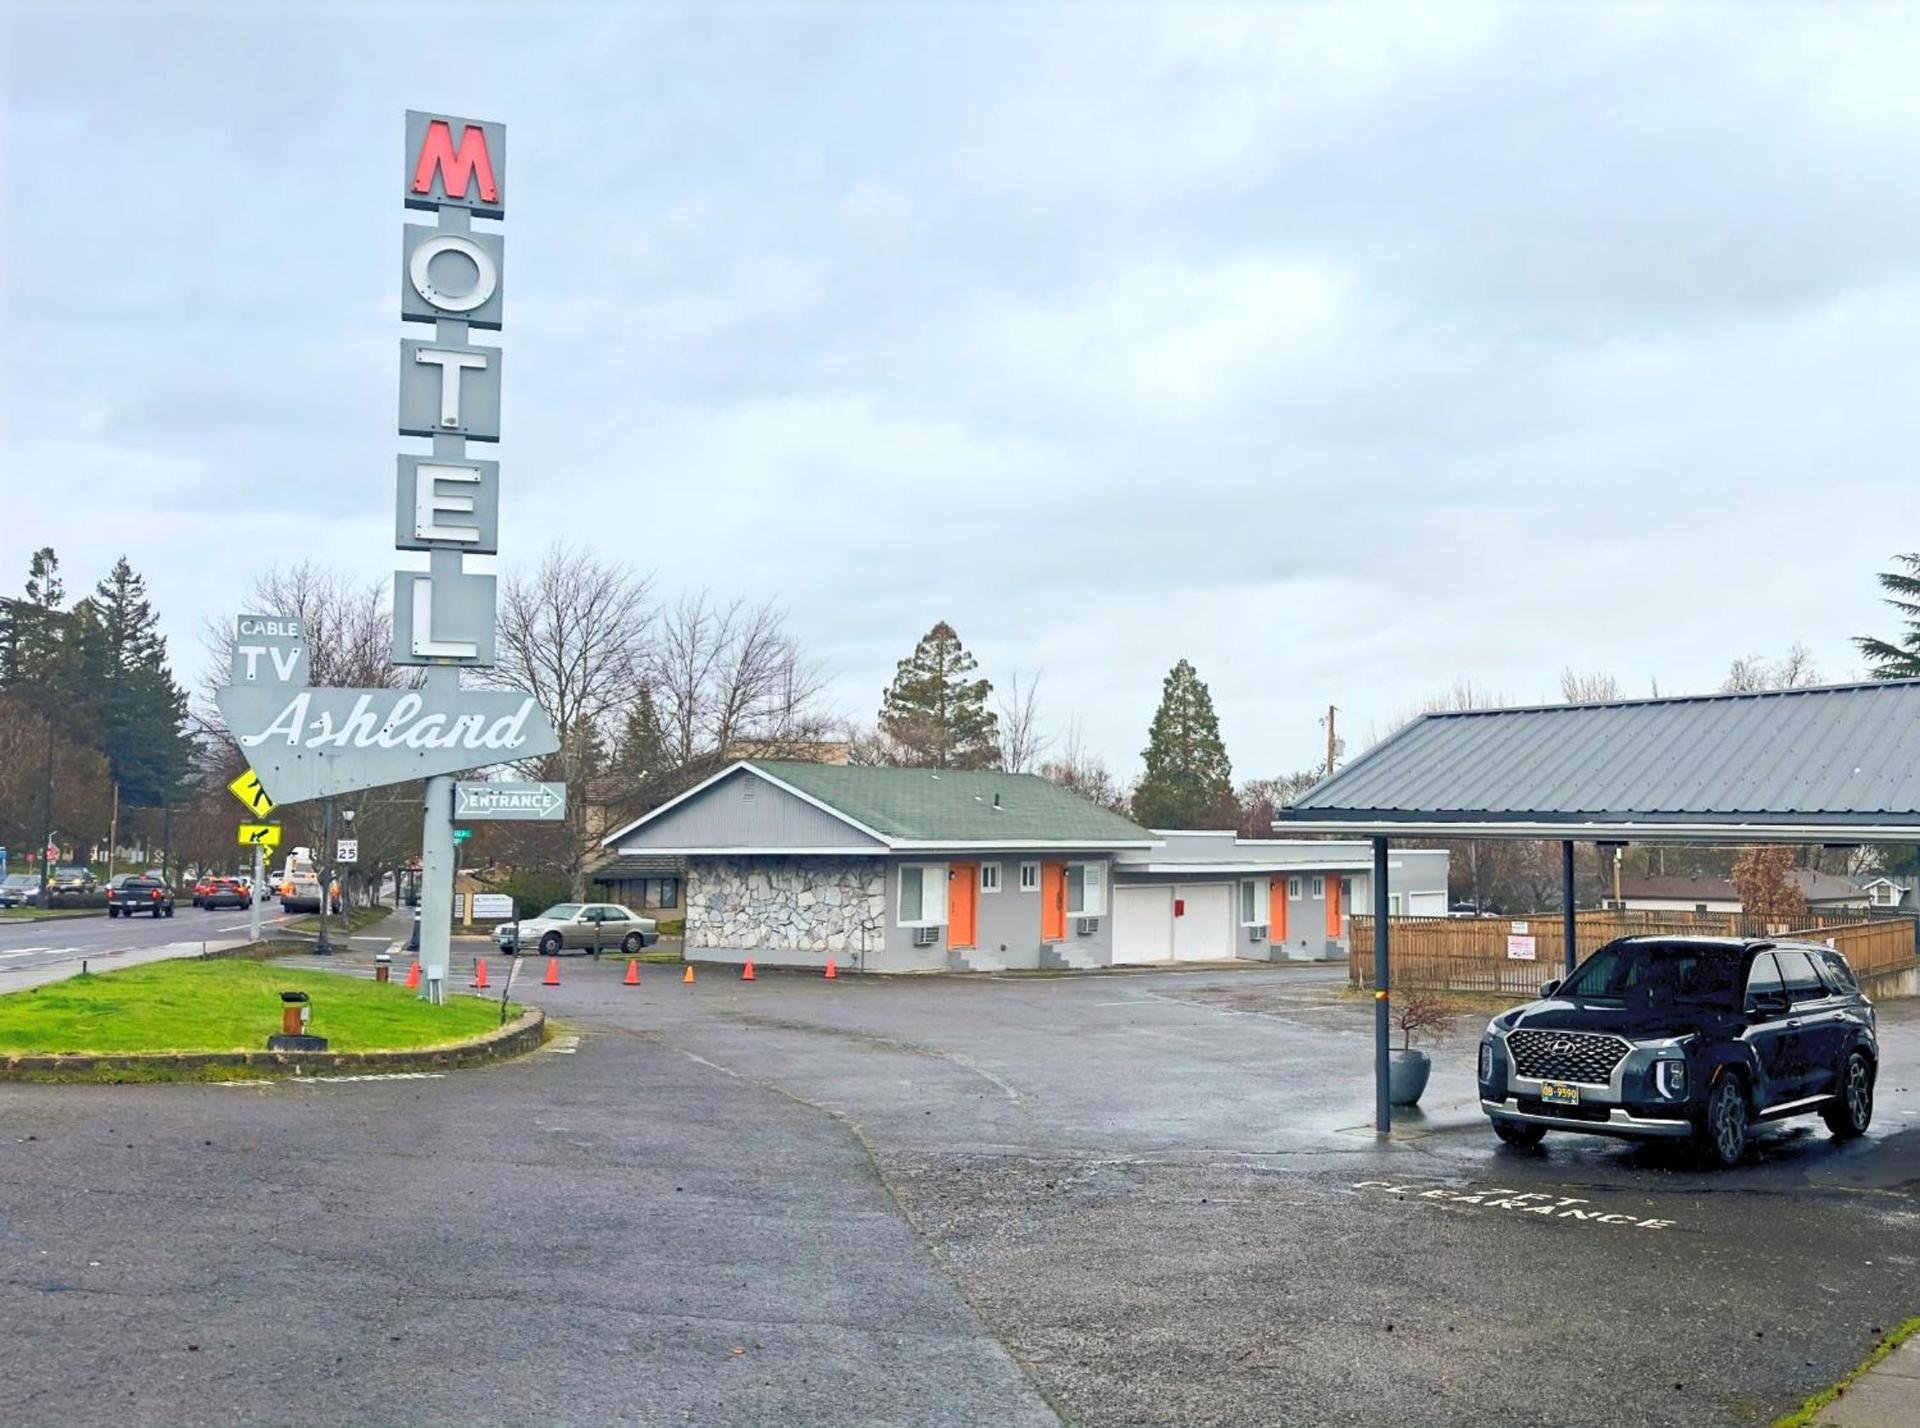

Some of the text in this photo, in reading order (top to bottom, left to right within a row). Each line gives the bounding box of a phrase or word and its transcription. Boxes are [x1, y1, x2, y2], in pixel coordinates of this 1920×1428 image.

[411, 119, 499, 658] MOTEL
[240, 620, 299, 637] CABLE
[238, 645, 303, 682] TV
[241, 692, 537, 750] Ashland
[468, 794, 552, 808] ENTRANCE
[339, 848, 356, 859] 25
[1352, 1181, 1677, 1230] CLEARANCE
